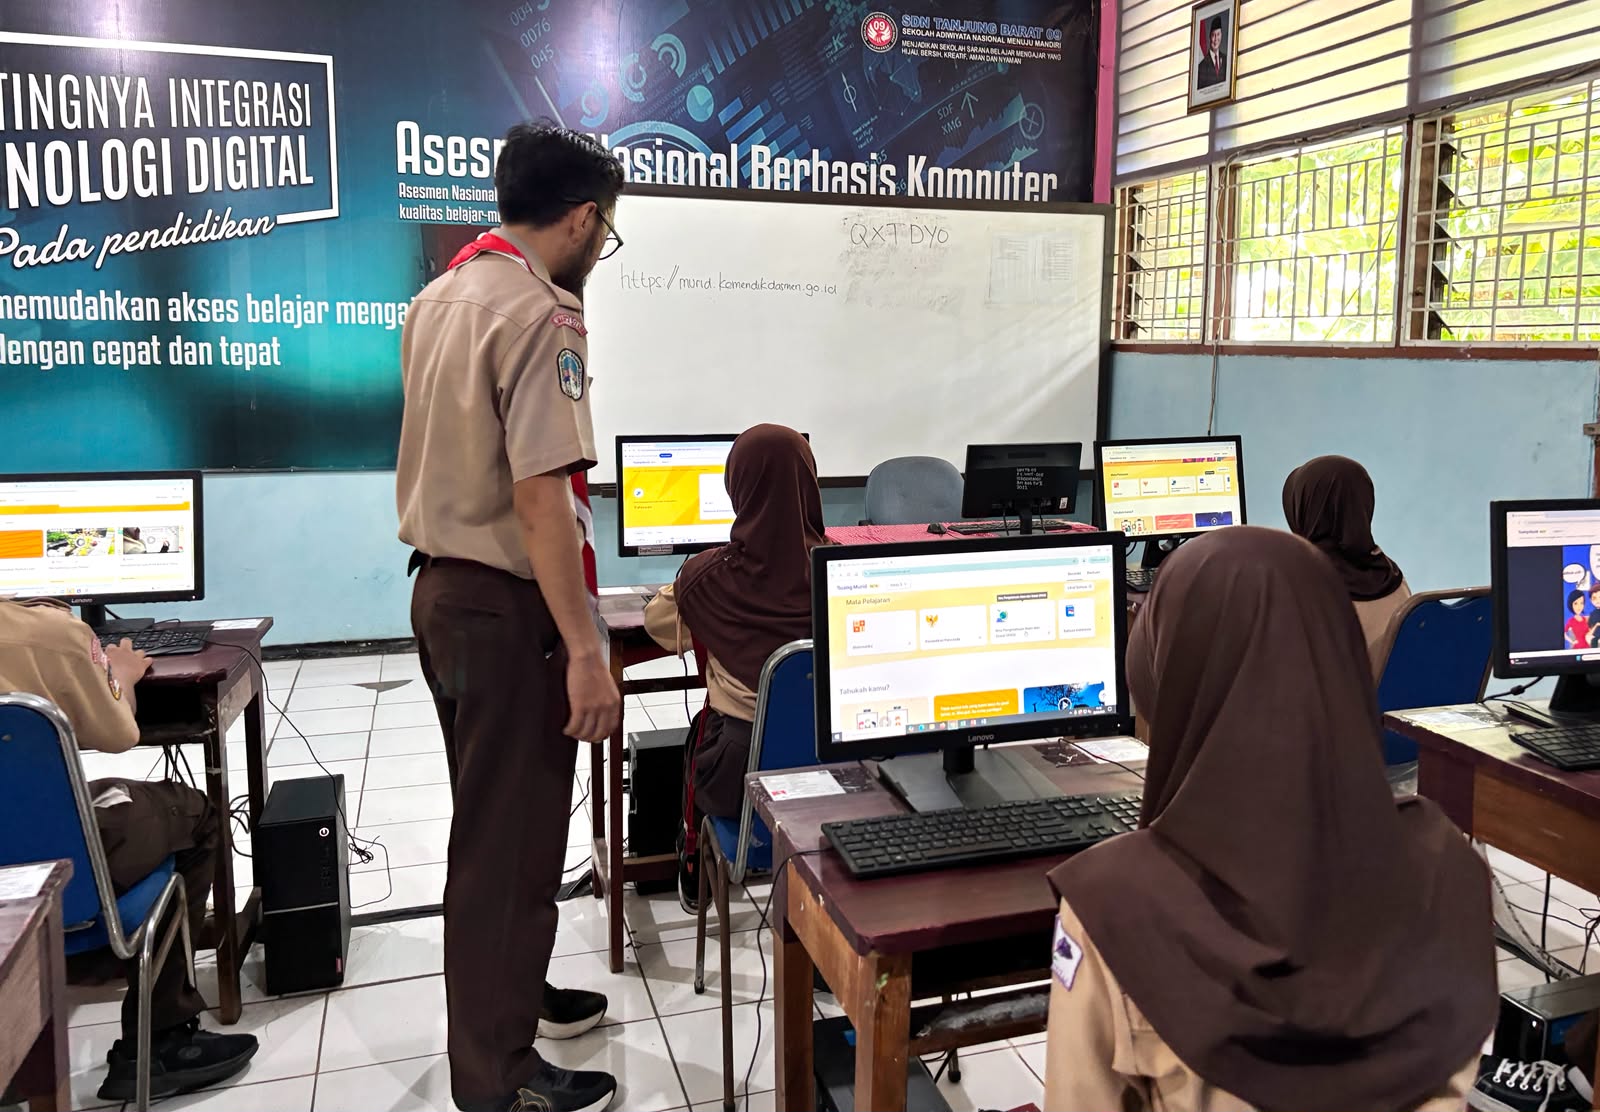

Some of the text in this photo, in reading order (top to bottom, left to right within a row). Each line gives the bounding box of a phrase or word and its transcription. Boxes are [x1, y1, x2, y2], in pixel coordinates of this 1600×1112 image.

[873, 20, 886, 31] 09
[902, 14, 930, 28] SDN
[933, 17, 998, 35] TANJUNG
[1000, 23, 1044, 39] BARAT
[1046, 28, 1062, 41] 09
[902, 28, 1062, 49] SEKOLAH ADIWIYATA NASIONAL MENUJU MANDIRI
[902, 40, 938, 49] MENJADIKAN
[939, 42, 966, 52] SEKOLAH
[966, 46, 990, 54] SARANA
[990, 48, 1015, 56] BELAJAR
[1016, 50, 1046, 60] MENGAJAR
[1046, 53, 1062, 61] YANG
[968, 54, 985, 62] AMAN
[998, 56, 1022, 65] NYAMAN
[168, 77, 312, 129] INTEGRASI
[396, 120, 506, 179] Ases
[751, 144, 897, 196] Berbasis
[5, 134, 314, 210] NOLOGI DIGITAL
[398, 182, 498, 202] Asesmen Nasional
[399, 203, 501, 224] kualitas belajar-m
[0, 206, 276, 270] Pada pendidikan
[168, 291, 239, 324] akses
[246, 293, 330, 328] belajar
[335, 297, 413, 330] menga
[92, 335, 162, 371] cepat
[168, 337, 213, 366] dan
[219, 336, 282, 371] tepat
[968, 734, 994, 742] Lenovo
